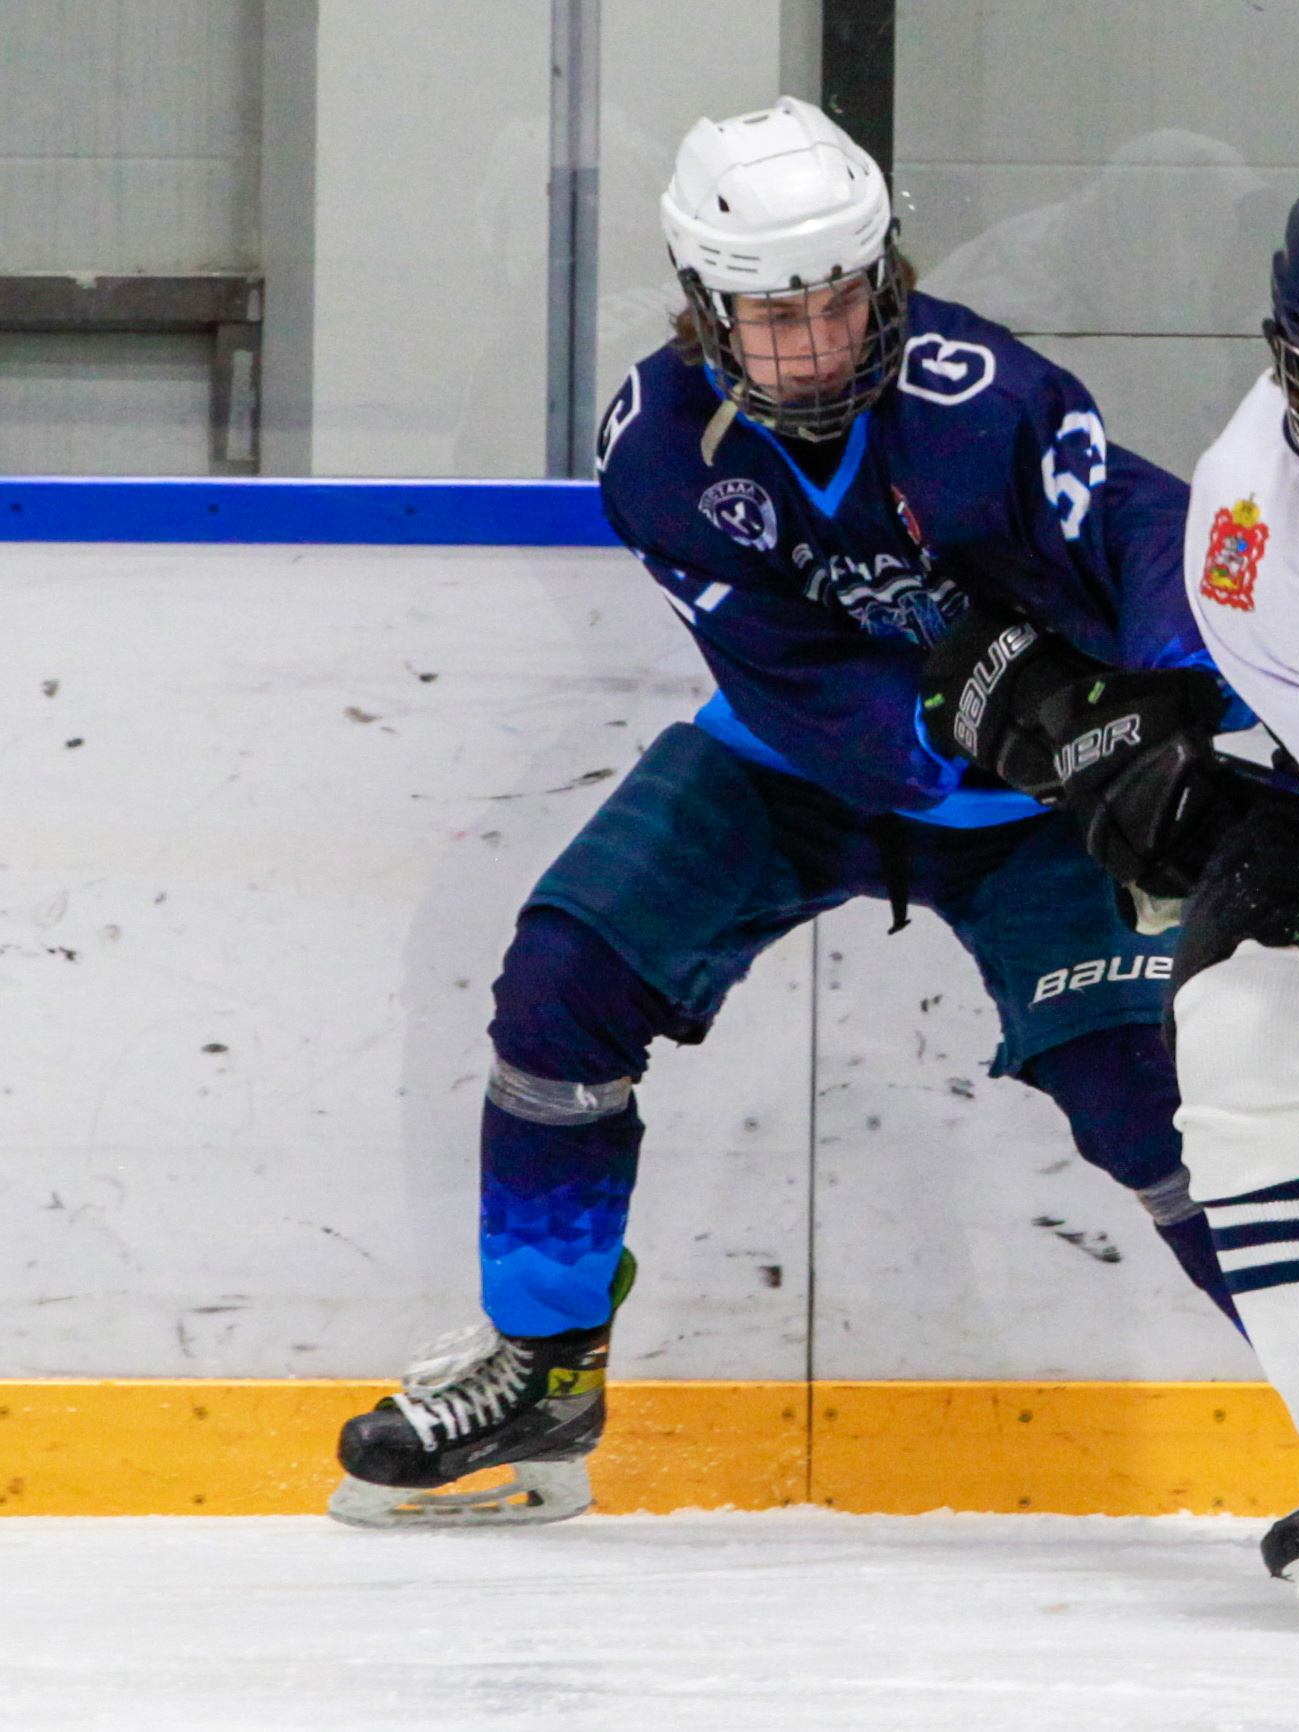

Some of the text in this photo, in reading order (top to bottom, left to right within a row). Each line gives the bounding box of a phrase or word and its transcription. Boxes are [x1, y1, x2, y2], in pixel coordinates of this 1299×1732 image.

[953, 621, 1038, 758] BAUE
[1053, 713, 1142, 784] UER
[1030, 954, 1175, 1010] BAUE
